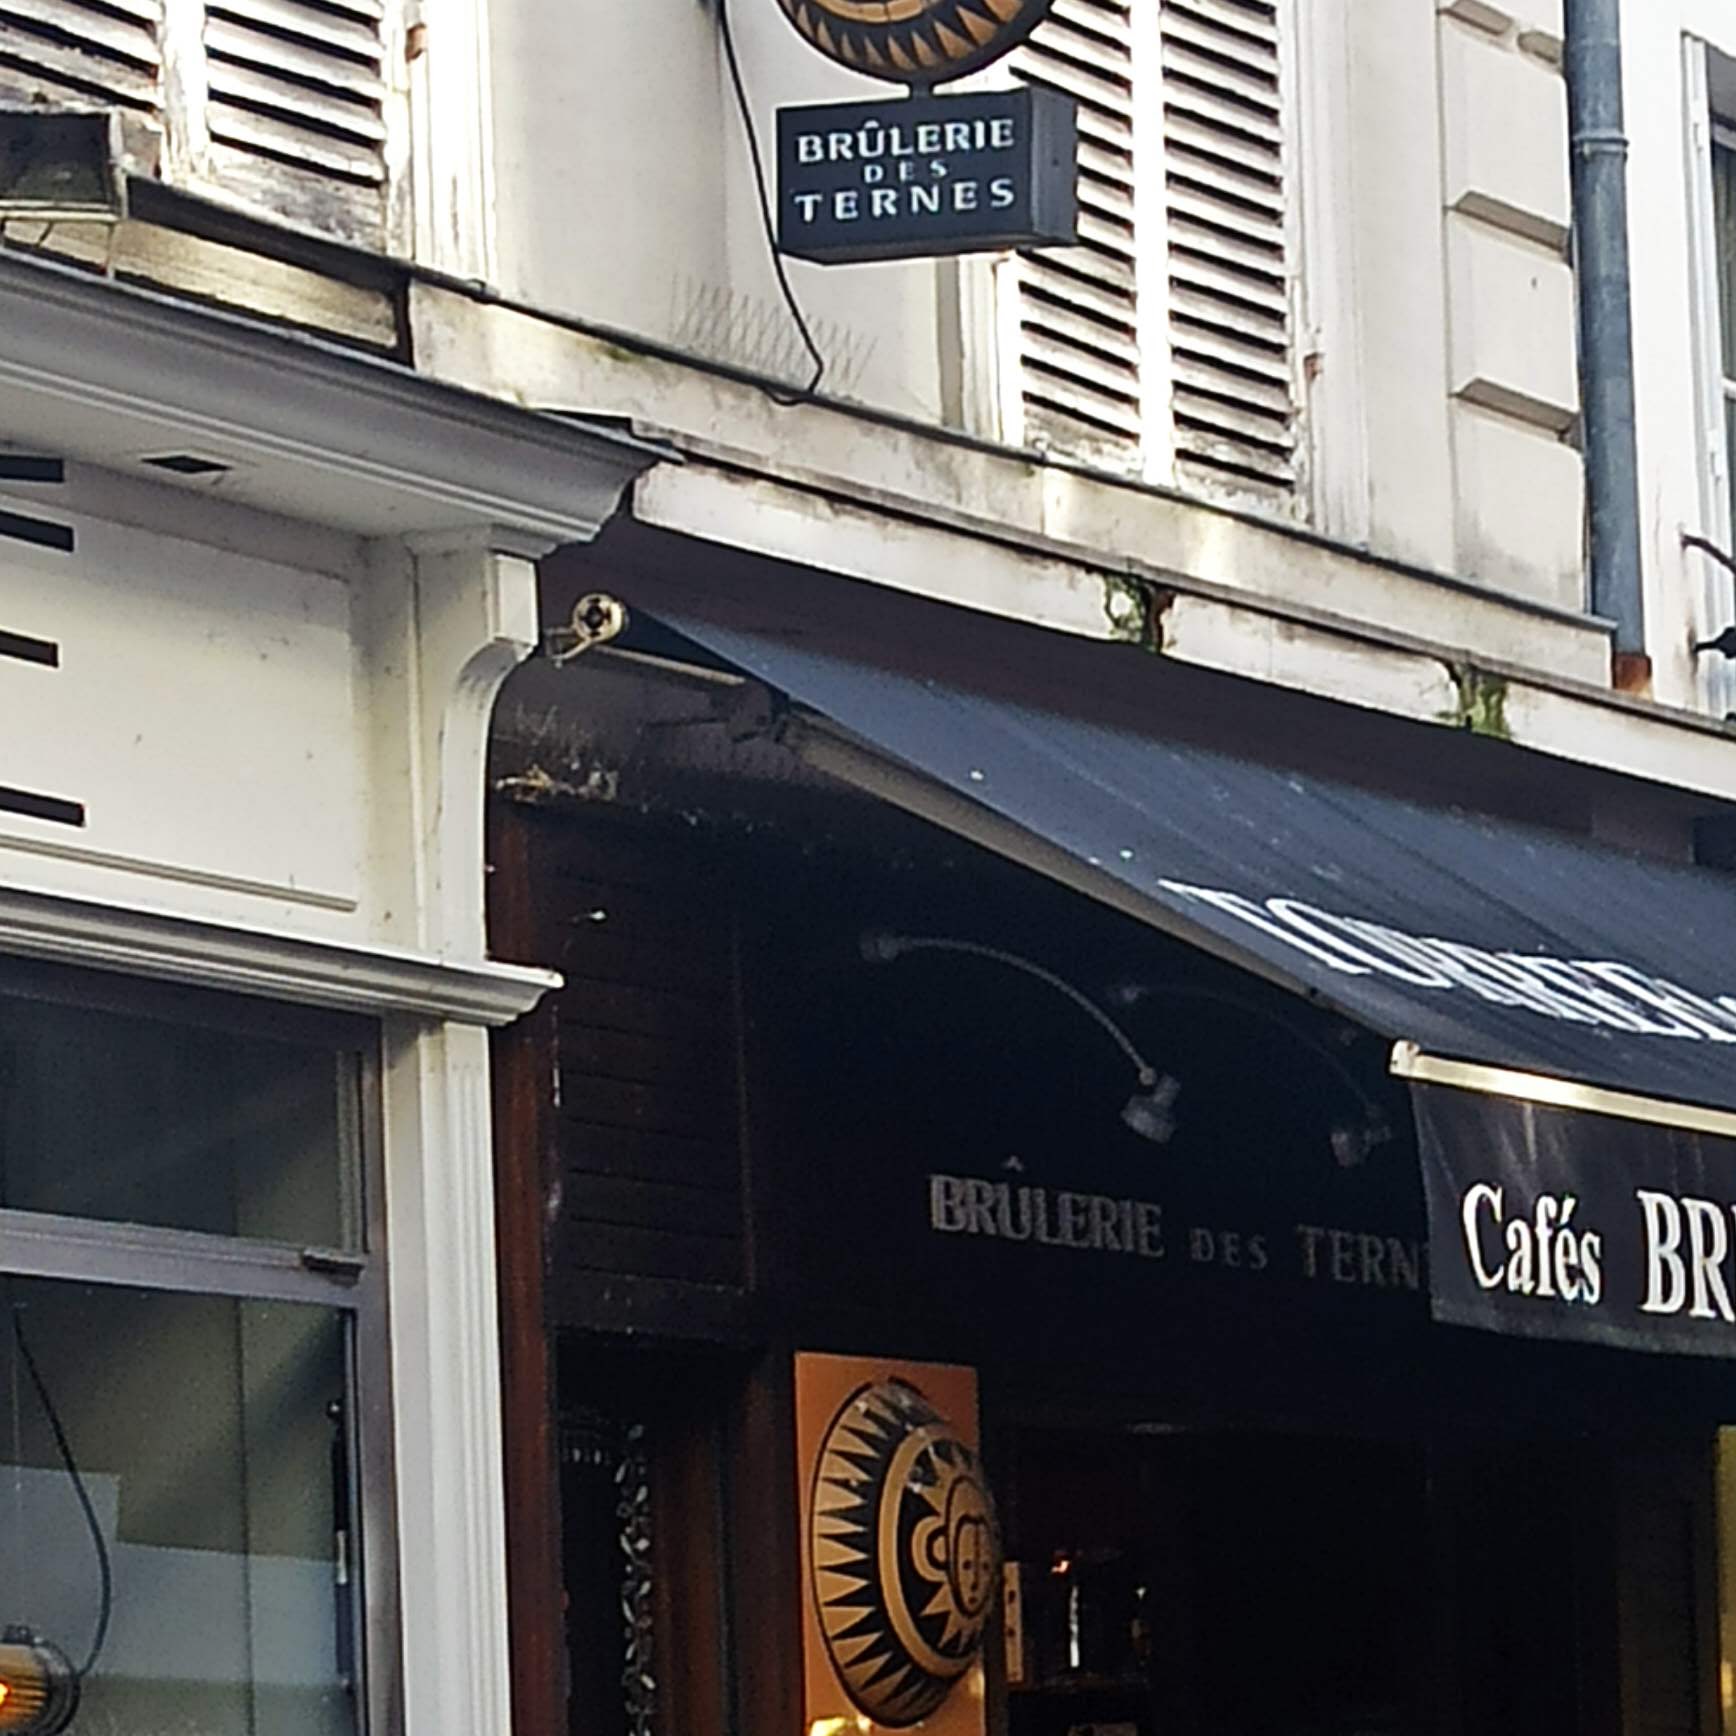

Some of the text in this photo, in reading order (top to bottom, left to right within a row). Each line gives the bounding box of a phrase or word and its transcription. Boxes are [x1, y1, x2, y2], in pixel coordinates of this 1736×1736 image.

[798, 118, 1014, 162] BRÛLERIE
[864, 160, 948, 183] DES
[794, 178, 1014, 223] TERNES
[929, 1155, 1426, 1290] BRÛLERIE DES TERN
[1461, 1182, 1601, 1305] Cafés
